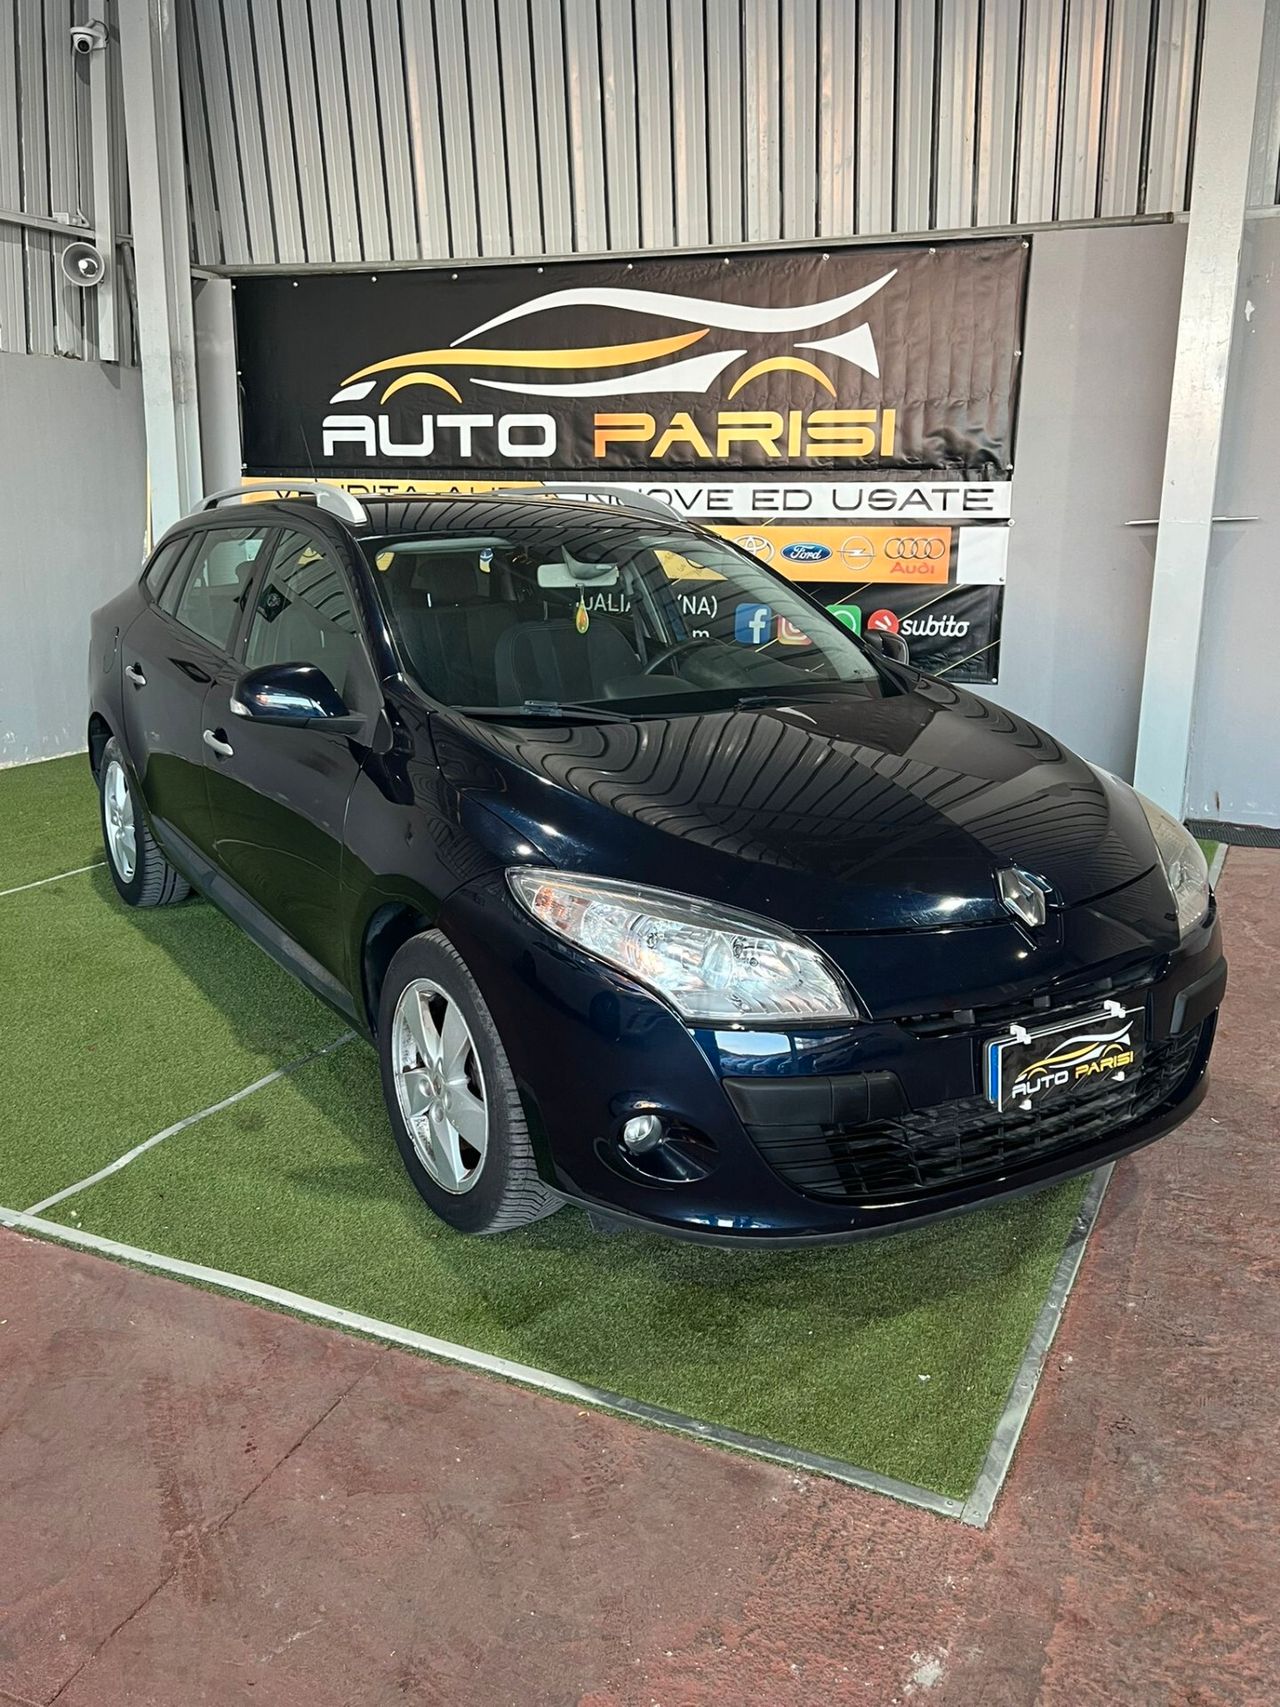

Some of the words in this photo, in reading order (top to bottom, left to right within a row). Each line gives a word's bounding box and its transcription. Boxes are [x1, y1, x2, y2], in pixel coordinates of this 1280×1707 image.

[322, 413, 557, 457] AUTO
[594, 409, 896, 458] PARISI
[752, 489, 812, 511] ED
[832, 488, 995, 511] USATE
[790, 544, 822, 560] Ford
[890, 562, 935, 574] Audi
[901, 615, 970, 638] subito
[1012, 1071, 1069, 1099] AUTO
[1075, 1051, 1133, 1079] PARISI
